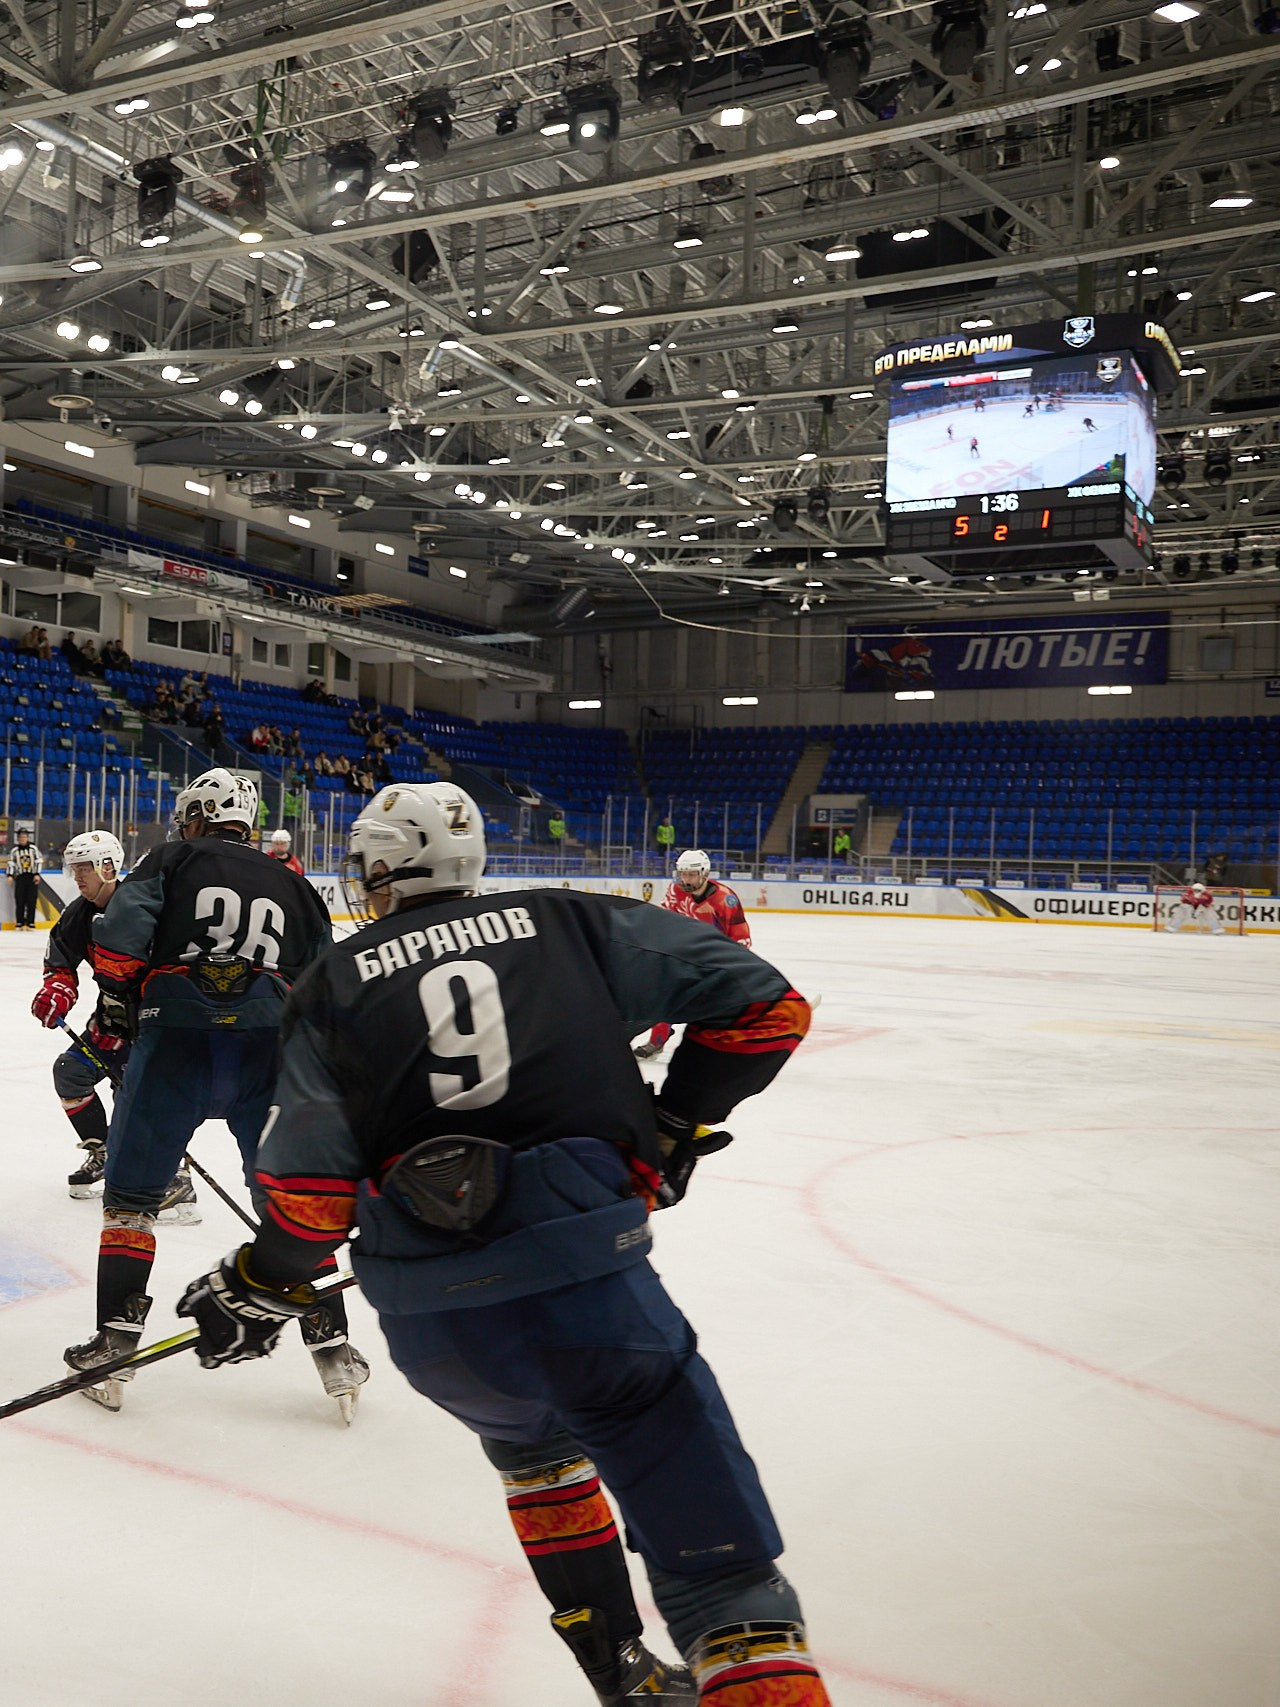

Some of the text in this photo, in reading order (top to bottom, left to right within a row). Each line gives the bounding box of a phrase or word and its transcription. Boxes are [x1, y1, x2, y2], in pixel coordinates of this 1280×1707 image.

[896, 333, 1013, 367] ПРЕДЕЛАМИ
[980, 493, 1020, 515] 1:36
[954, 515, 970, 536] 5
[1041, 509, 1051, 529] 1
[994, 524, 1008, 542] 2
[172, 565, 207, 583] SPAR
[957, 631, 1152, 671] ЛЮТЫЕ!
[237, 793, 250, 811] 19
[447, 803, 470, 831] Z
[803, 889, 909, 907] OHLIGA.RU
[179, 886, 285, 971] 36
[353, 907, 538, 983] БАРАНОВ
[418, 960, 512, 1111] 9
